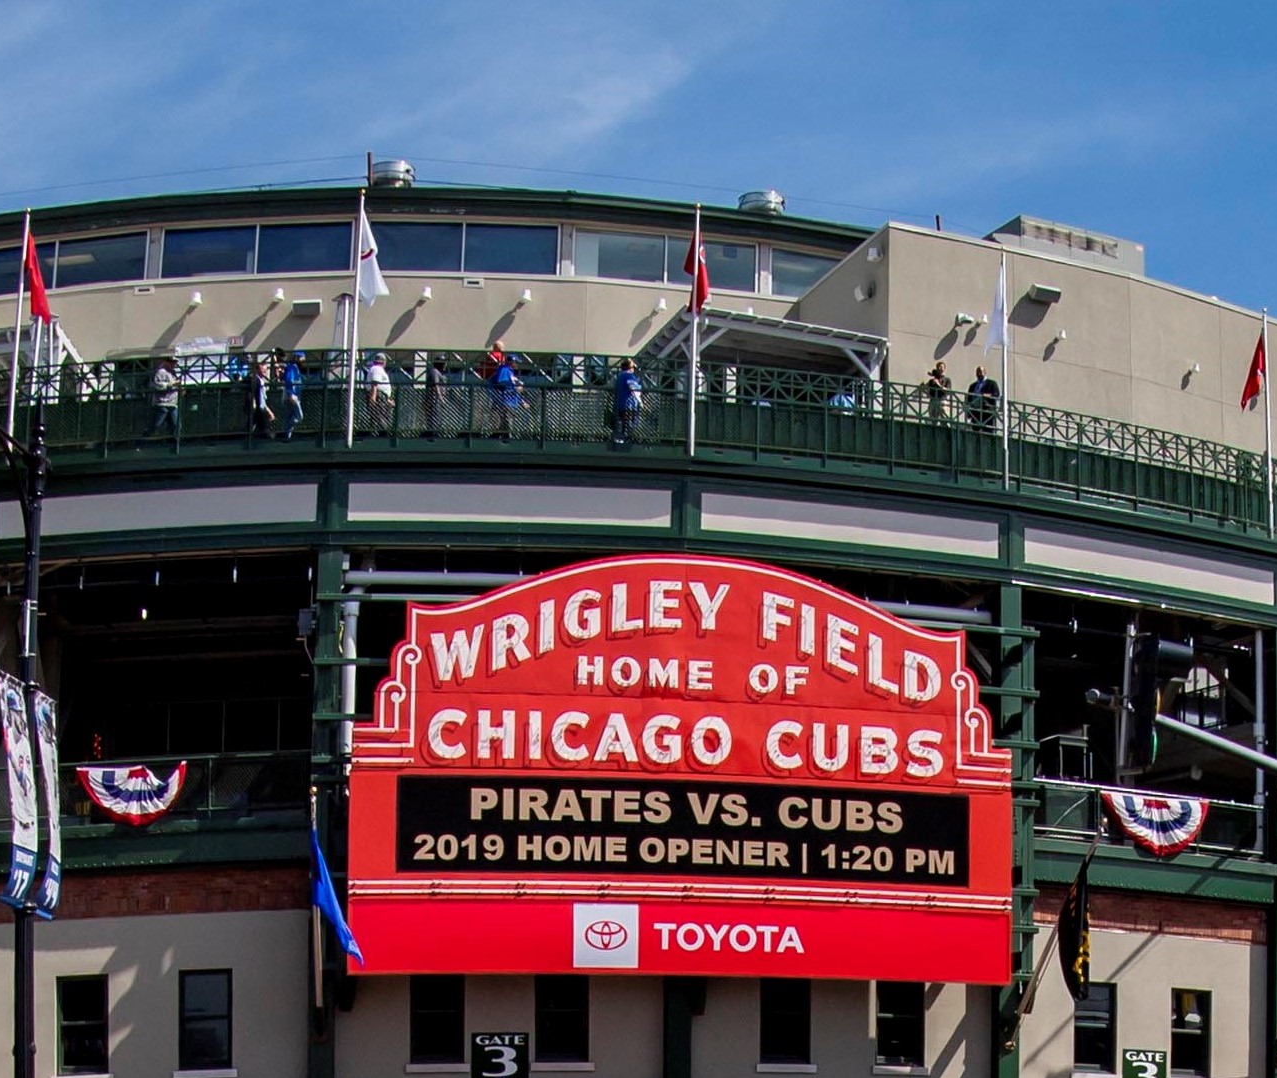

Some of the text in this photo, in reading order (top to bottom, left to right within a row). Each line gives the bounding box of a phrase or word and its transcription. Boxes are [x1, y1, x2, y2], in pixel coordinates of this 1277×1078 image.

[429, 580, 943, 702] WRIGLEY FIELD
[577, 655, 810, 696] HOME OF
[428, 709, 945, 779] CHICAGO CUBS
[470, 787, 904, 833] PIRATES VS. CUBS
[413, 834, 505, 861] 2019
[517, 836, 628, 863] HOME
[639, 838, 790, 868] OPENER
[821, 845, 894, 872] 1:20
[905, 849, 956, 876] PM
[653, 923, 805, 954] TOYOTA
[475, 1034, 526, 1046] GATE
[1125, 1051, 1165, 1063] GATE
[481, 1045, 519, 1078] 3
